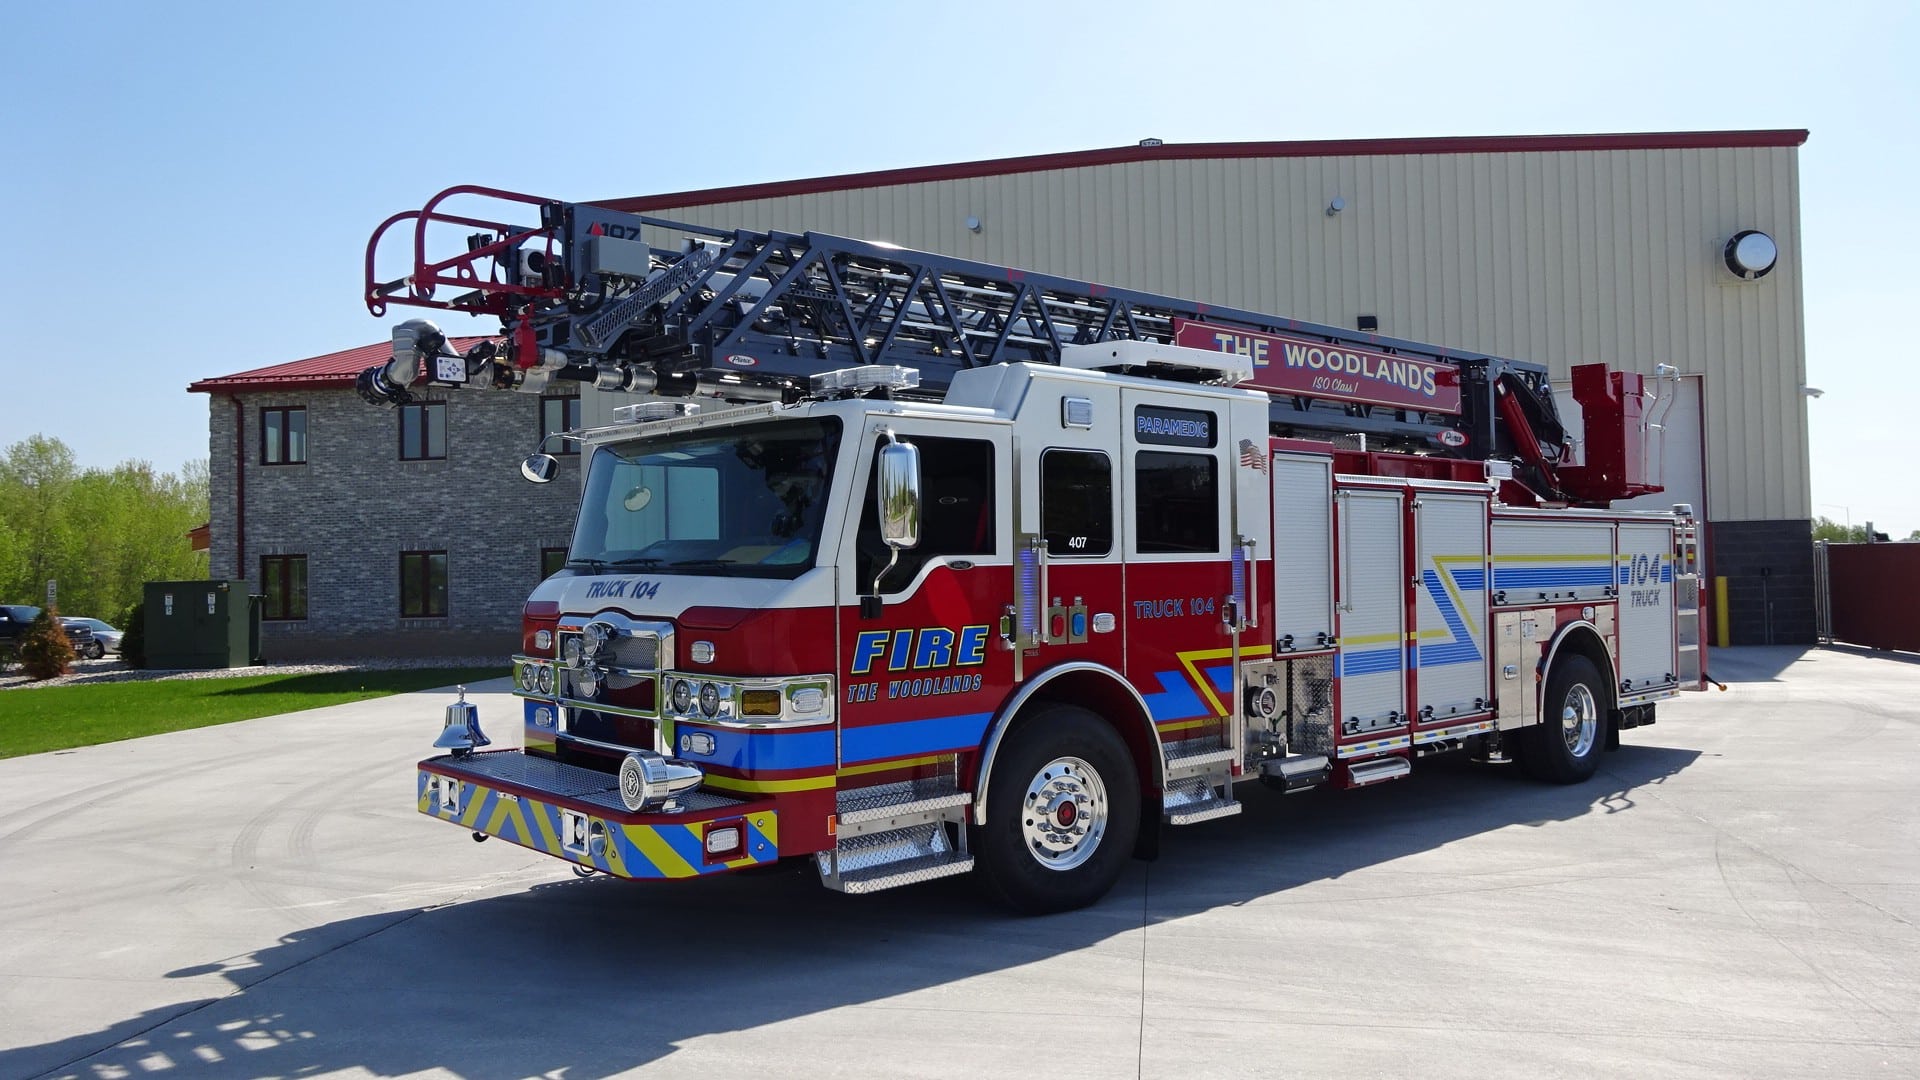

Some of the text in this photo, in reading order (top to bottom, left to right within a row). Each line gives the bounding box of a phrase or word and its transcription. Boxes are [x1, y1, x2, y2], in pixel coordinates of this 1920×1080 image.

[1215, 333, 1437, 396] THE WOODLANDS
[1312, 376, 1330, 389] ISO
[1331, 378, 1353, 393] Class
[1137, 416, 1208, 438] PARAMEDIC
[1069, 536, 1087, 549] 407
[1631, 553, 1660, 587] 104
[586, 580, 661, 600] TRUCK 104
[1631, 589, 1661, 608] TRUCK
[1134, 597, 1215, 619] TRUCK 104
[851, 624, 990, 674] FIRE
[848, 674, 982, 703] THE WOODLANDS
